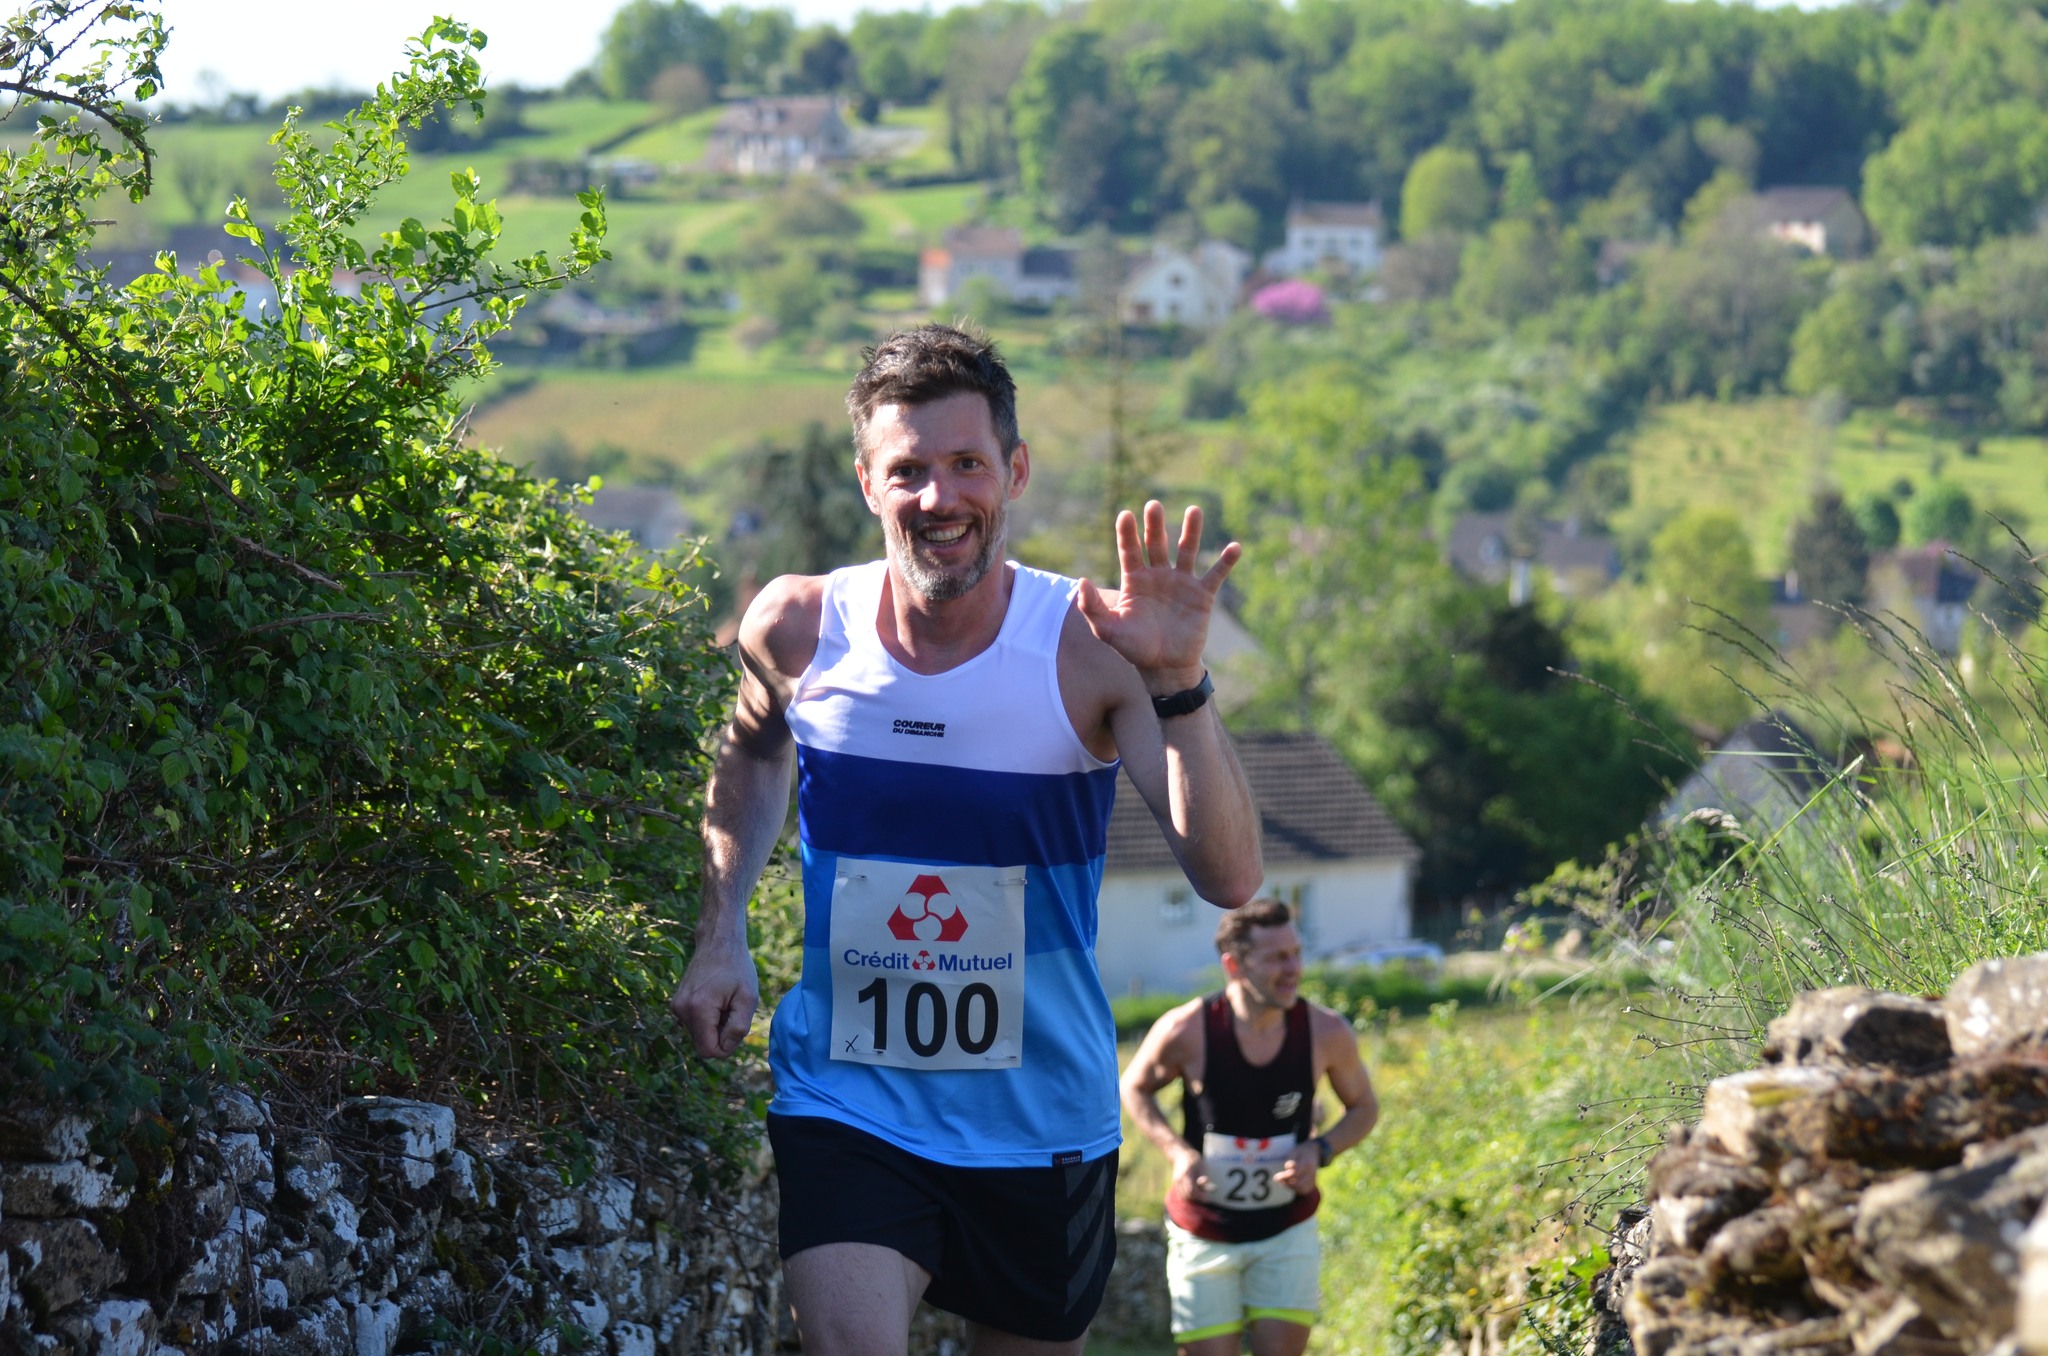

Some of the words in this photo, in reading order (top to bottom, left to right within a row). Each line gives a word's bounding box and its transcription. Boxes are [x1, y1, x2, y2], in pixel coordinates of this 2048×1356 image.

[893, 720, 945, 731] COUREUR
[904, 729, 944, 737] DIMANCHE
[843, 948, 910, 971] Crédit
[938, 952, 1013, 972] Mutuel
[858, 977, 999, 1058] 100
[1225, 1168, 1271, 1202] 23
